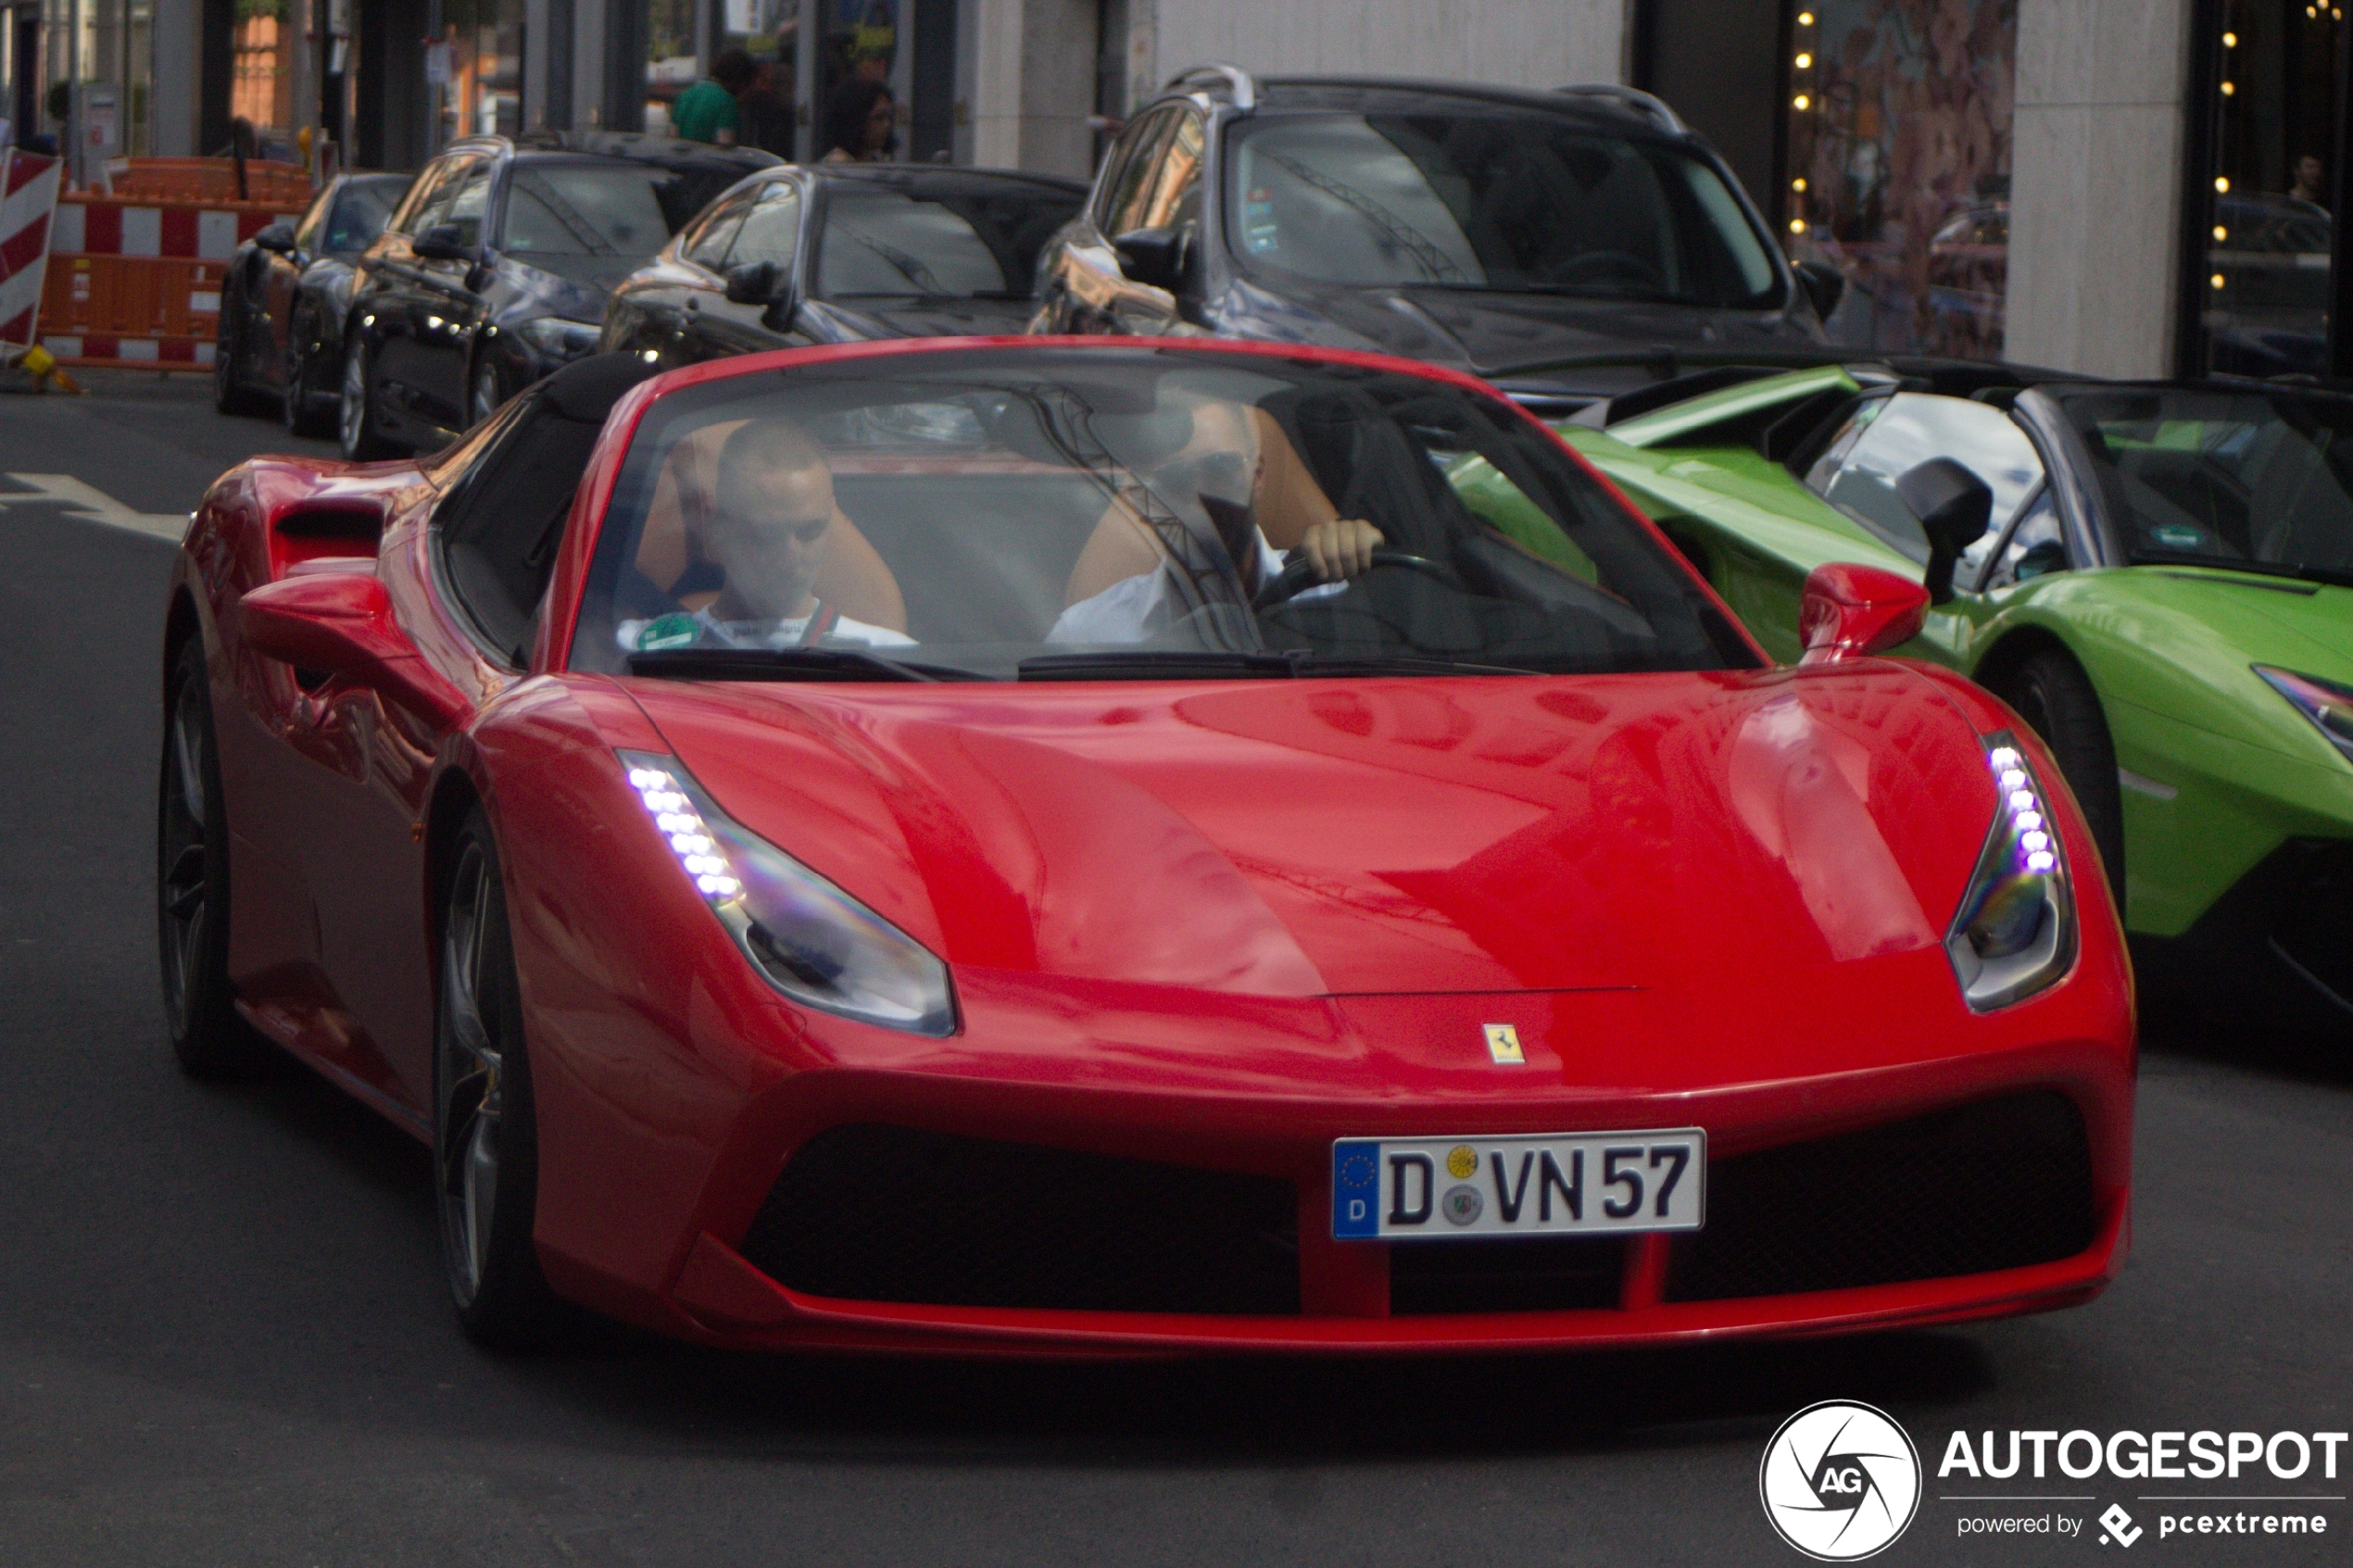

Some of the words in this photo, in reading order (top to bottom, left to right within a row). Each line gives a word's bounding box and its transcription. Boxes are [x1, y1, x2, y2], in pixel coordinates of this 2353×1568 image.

[1350, 1198, 1366, 1221] D
[1388, 1151, 1435, 1224] D
[1490, 1148, 1585, 1223] VN
[1603, 1144, 1692, 1220] 57
